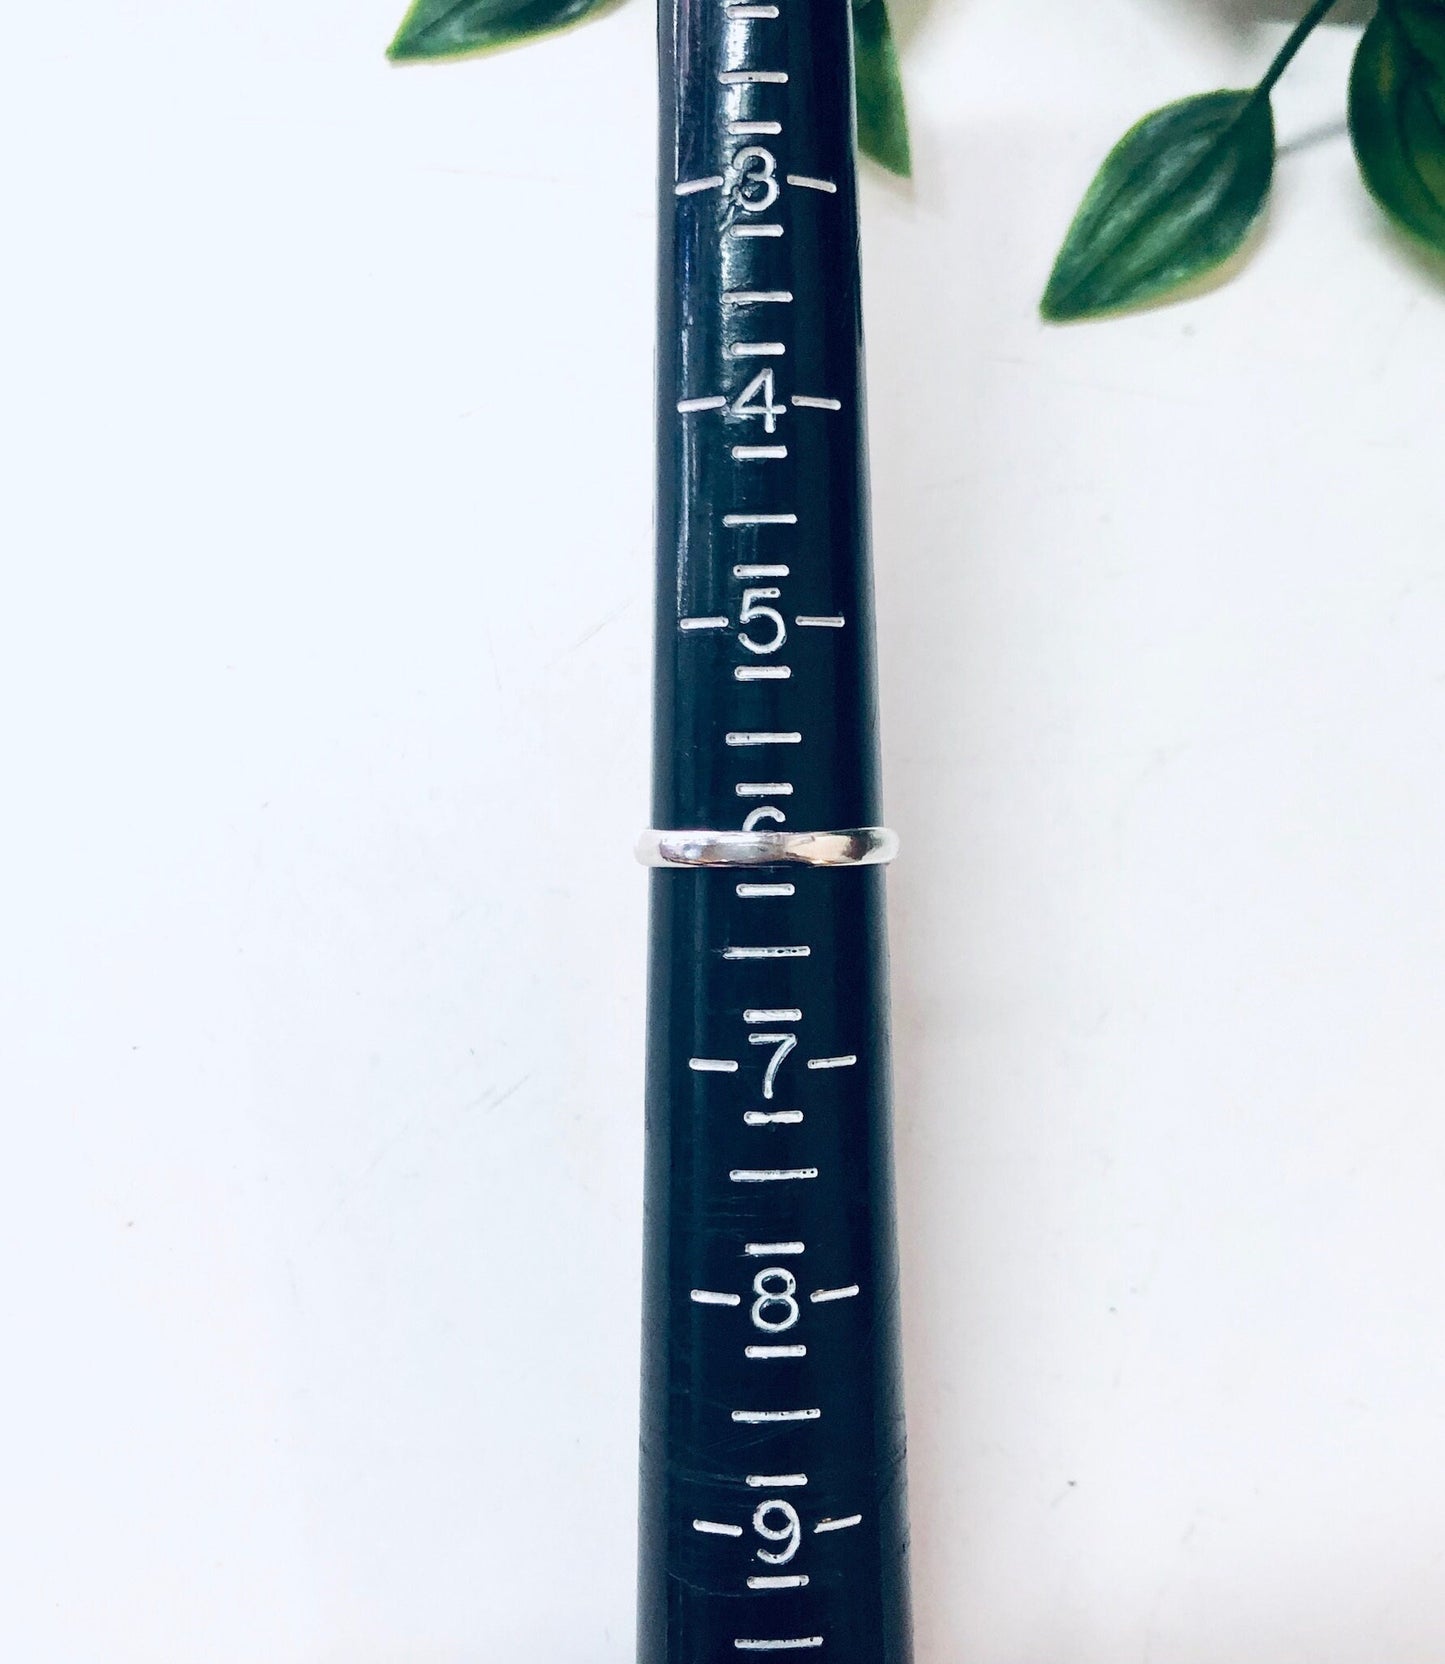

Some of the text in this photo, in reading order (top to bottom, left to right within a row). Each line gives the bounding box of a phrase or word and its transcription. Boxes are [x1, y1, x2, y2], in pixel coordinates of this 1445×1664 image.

[733, 146, 779, 212] 3
[732, 368, 787, 433] 4
[737, 588, 785, 655] 5
[749, 1034, 797, 1099] 7
[751, 1267, 799, 1332] 8
[752, 1500, 800, 1564] 9
